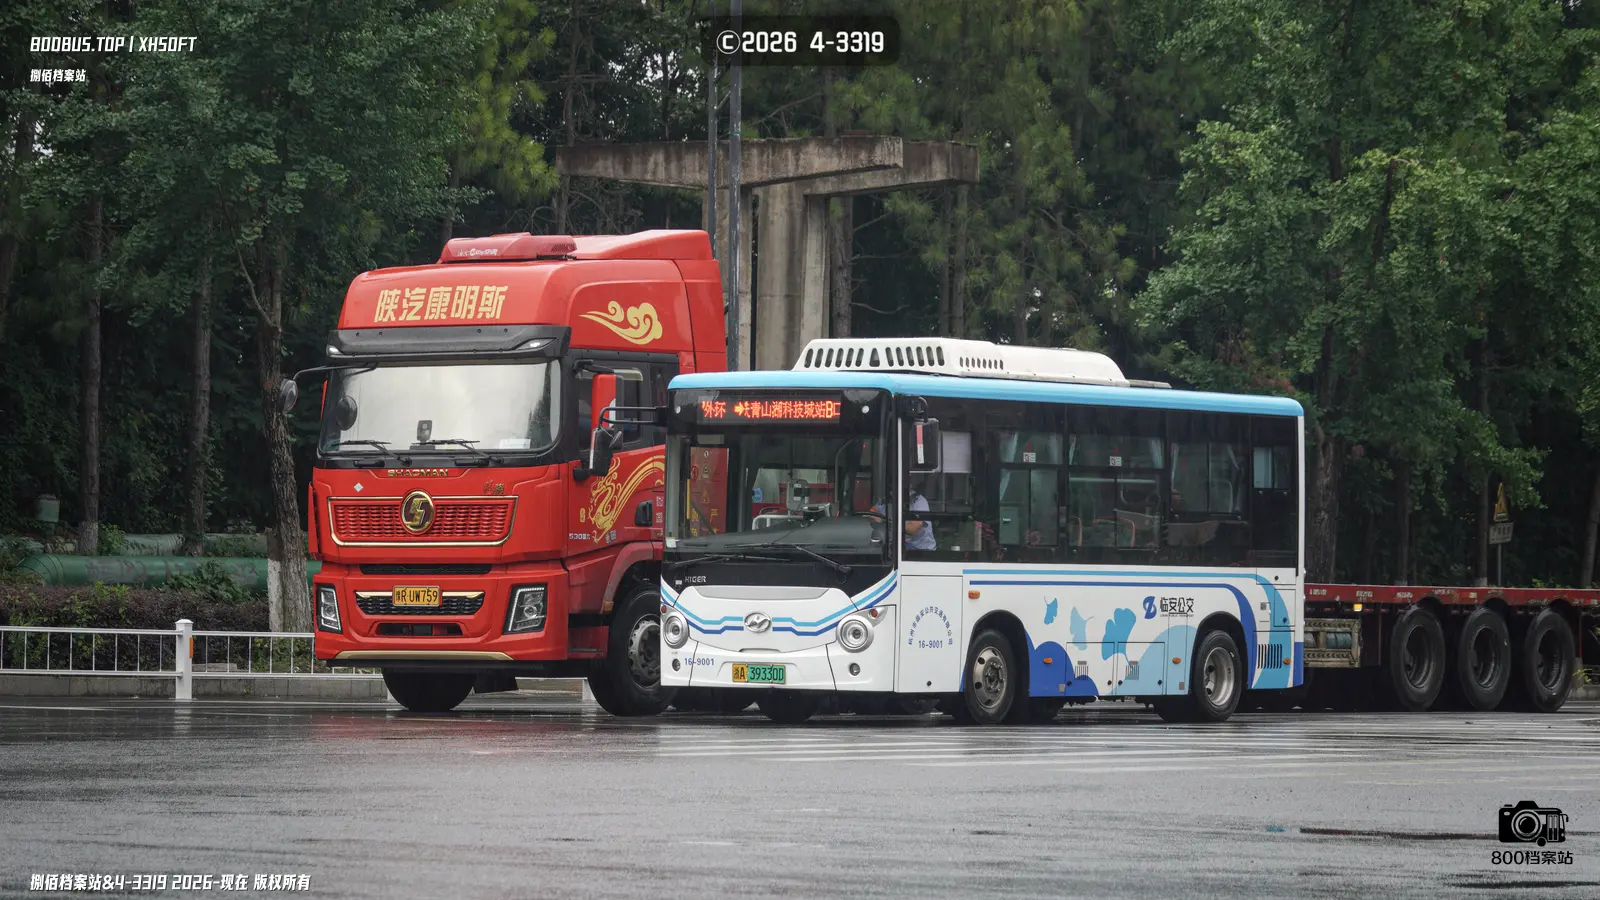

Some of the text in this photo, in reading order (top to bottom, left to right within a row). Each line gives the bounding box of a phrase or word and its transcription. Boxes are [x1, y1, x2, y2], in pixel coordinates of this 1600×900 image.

[374, 285, 508, 323] 陕汽康明斯
[387, 469, 449, 477] SHACMAN
[684, 575, 707, 583] HIGER
[1160, 597, 1195, 613] 临安公交
[918, 639, 943, 649] 16-9001
[684, 657, 715, 666] 16-9001
